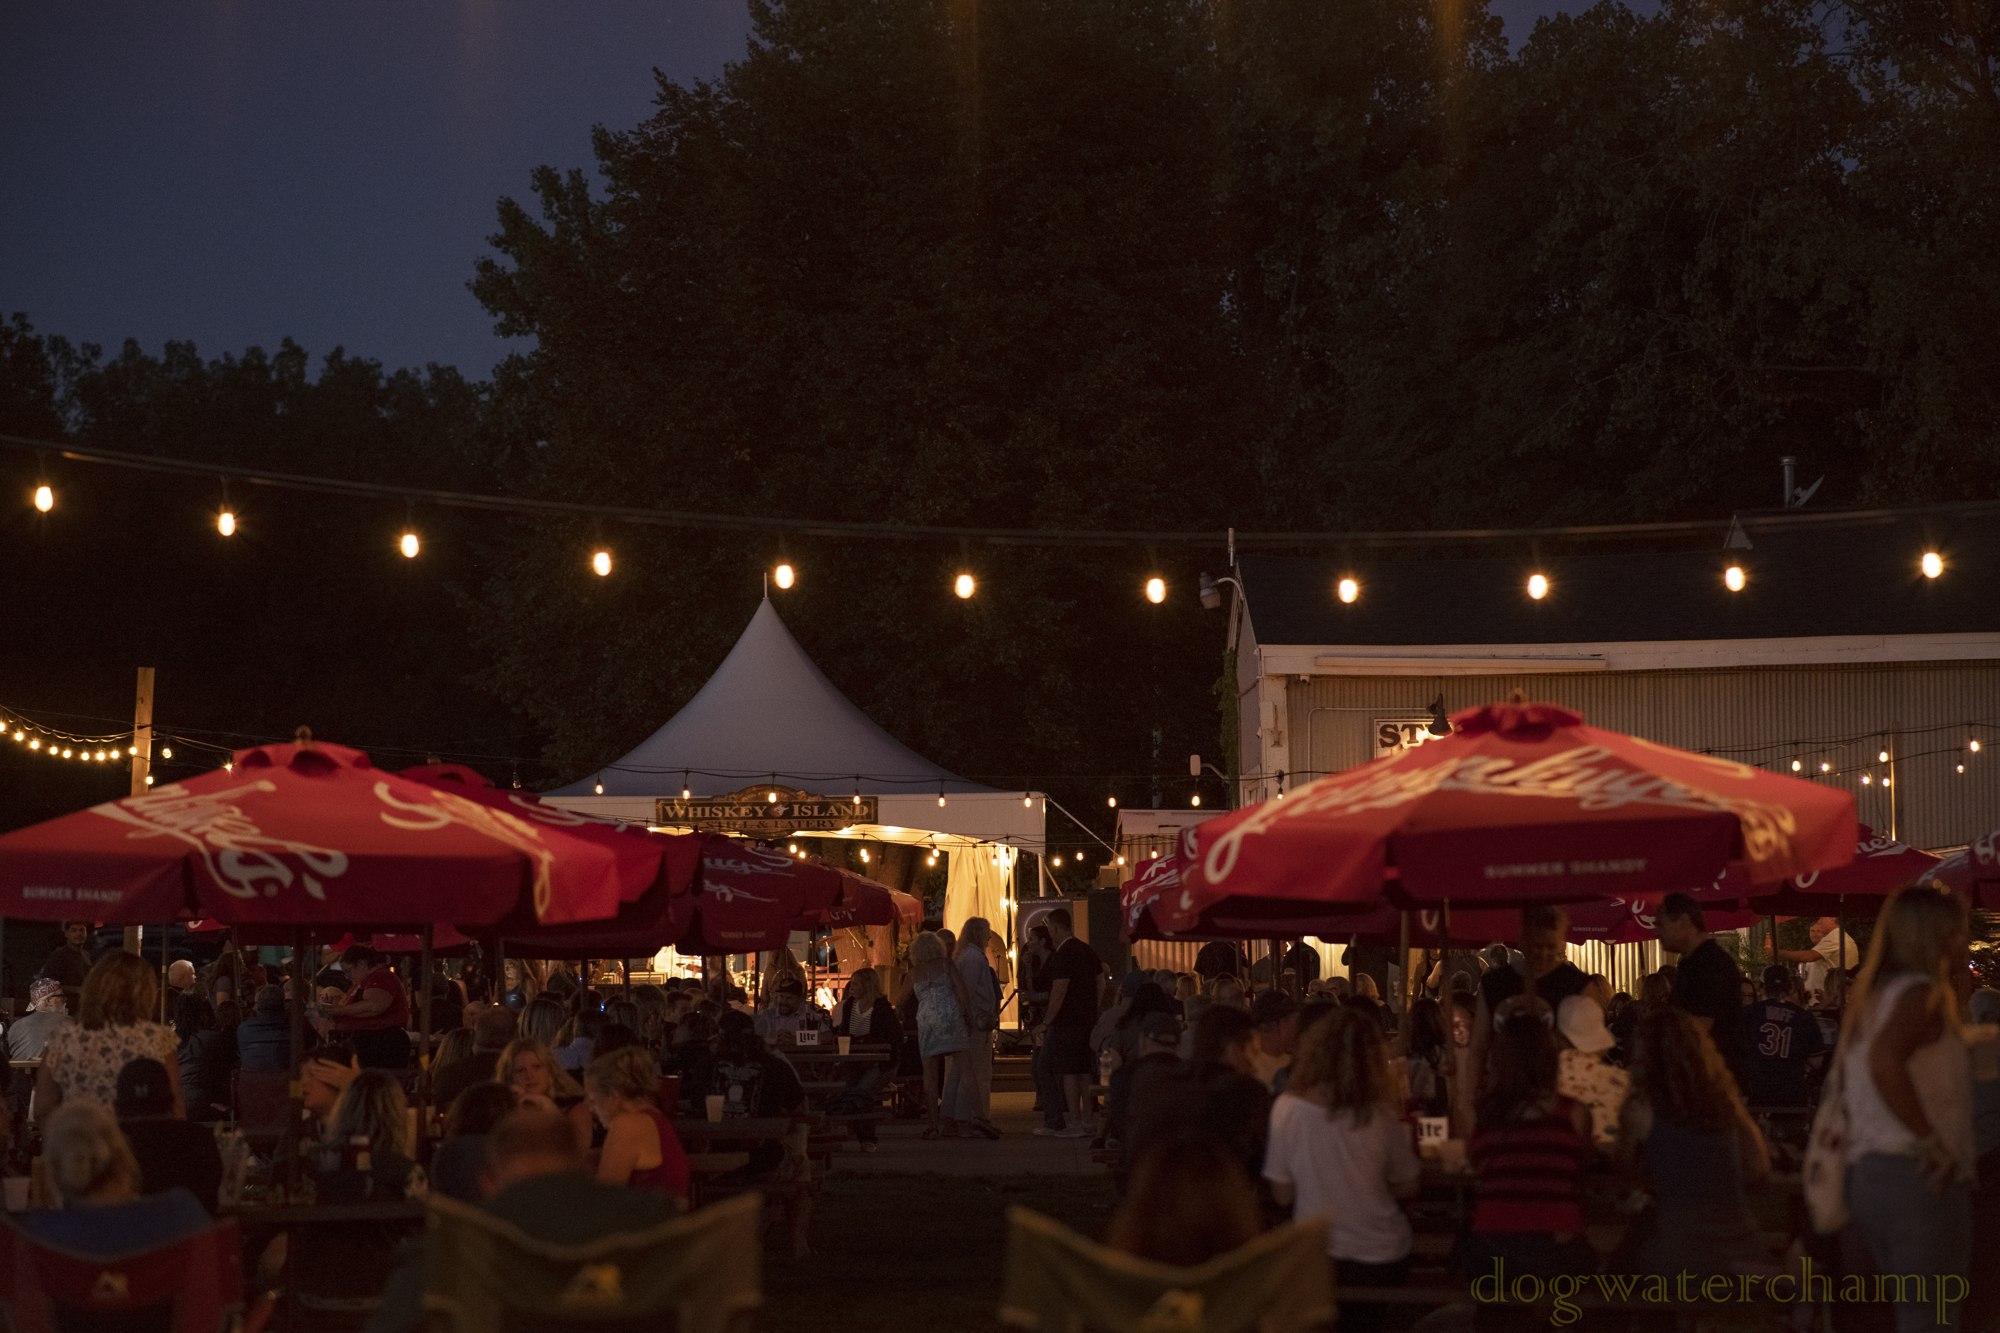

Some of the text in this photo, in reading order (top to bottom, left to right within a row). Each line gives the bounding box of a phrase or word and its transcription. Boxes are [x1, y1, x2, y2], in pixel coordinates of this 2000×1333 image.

[1379, 723, 1429, 748] ST
[665, 804, 869, 818] WHISKEY ISLAND
[774, 819, 837, 829] EATERY
[1758, 1022, 1793, 1059] 31
